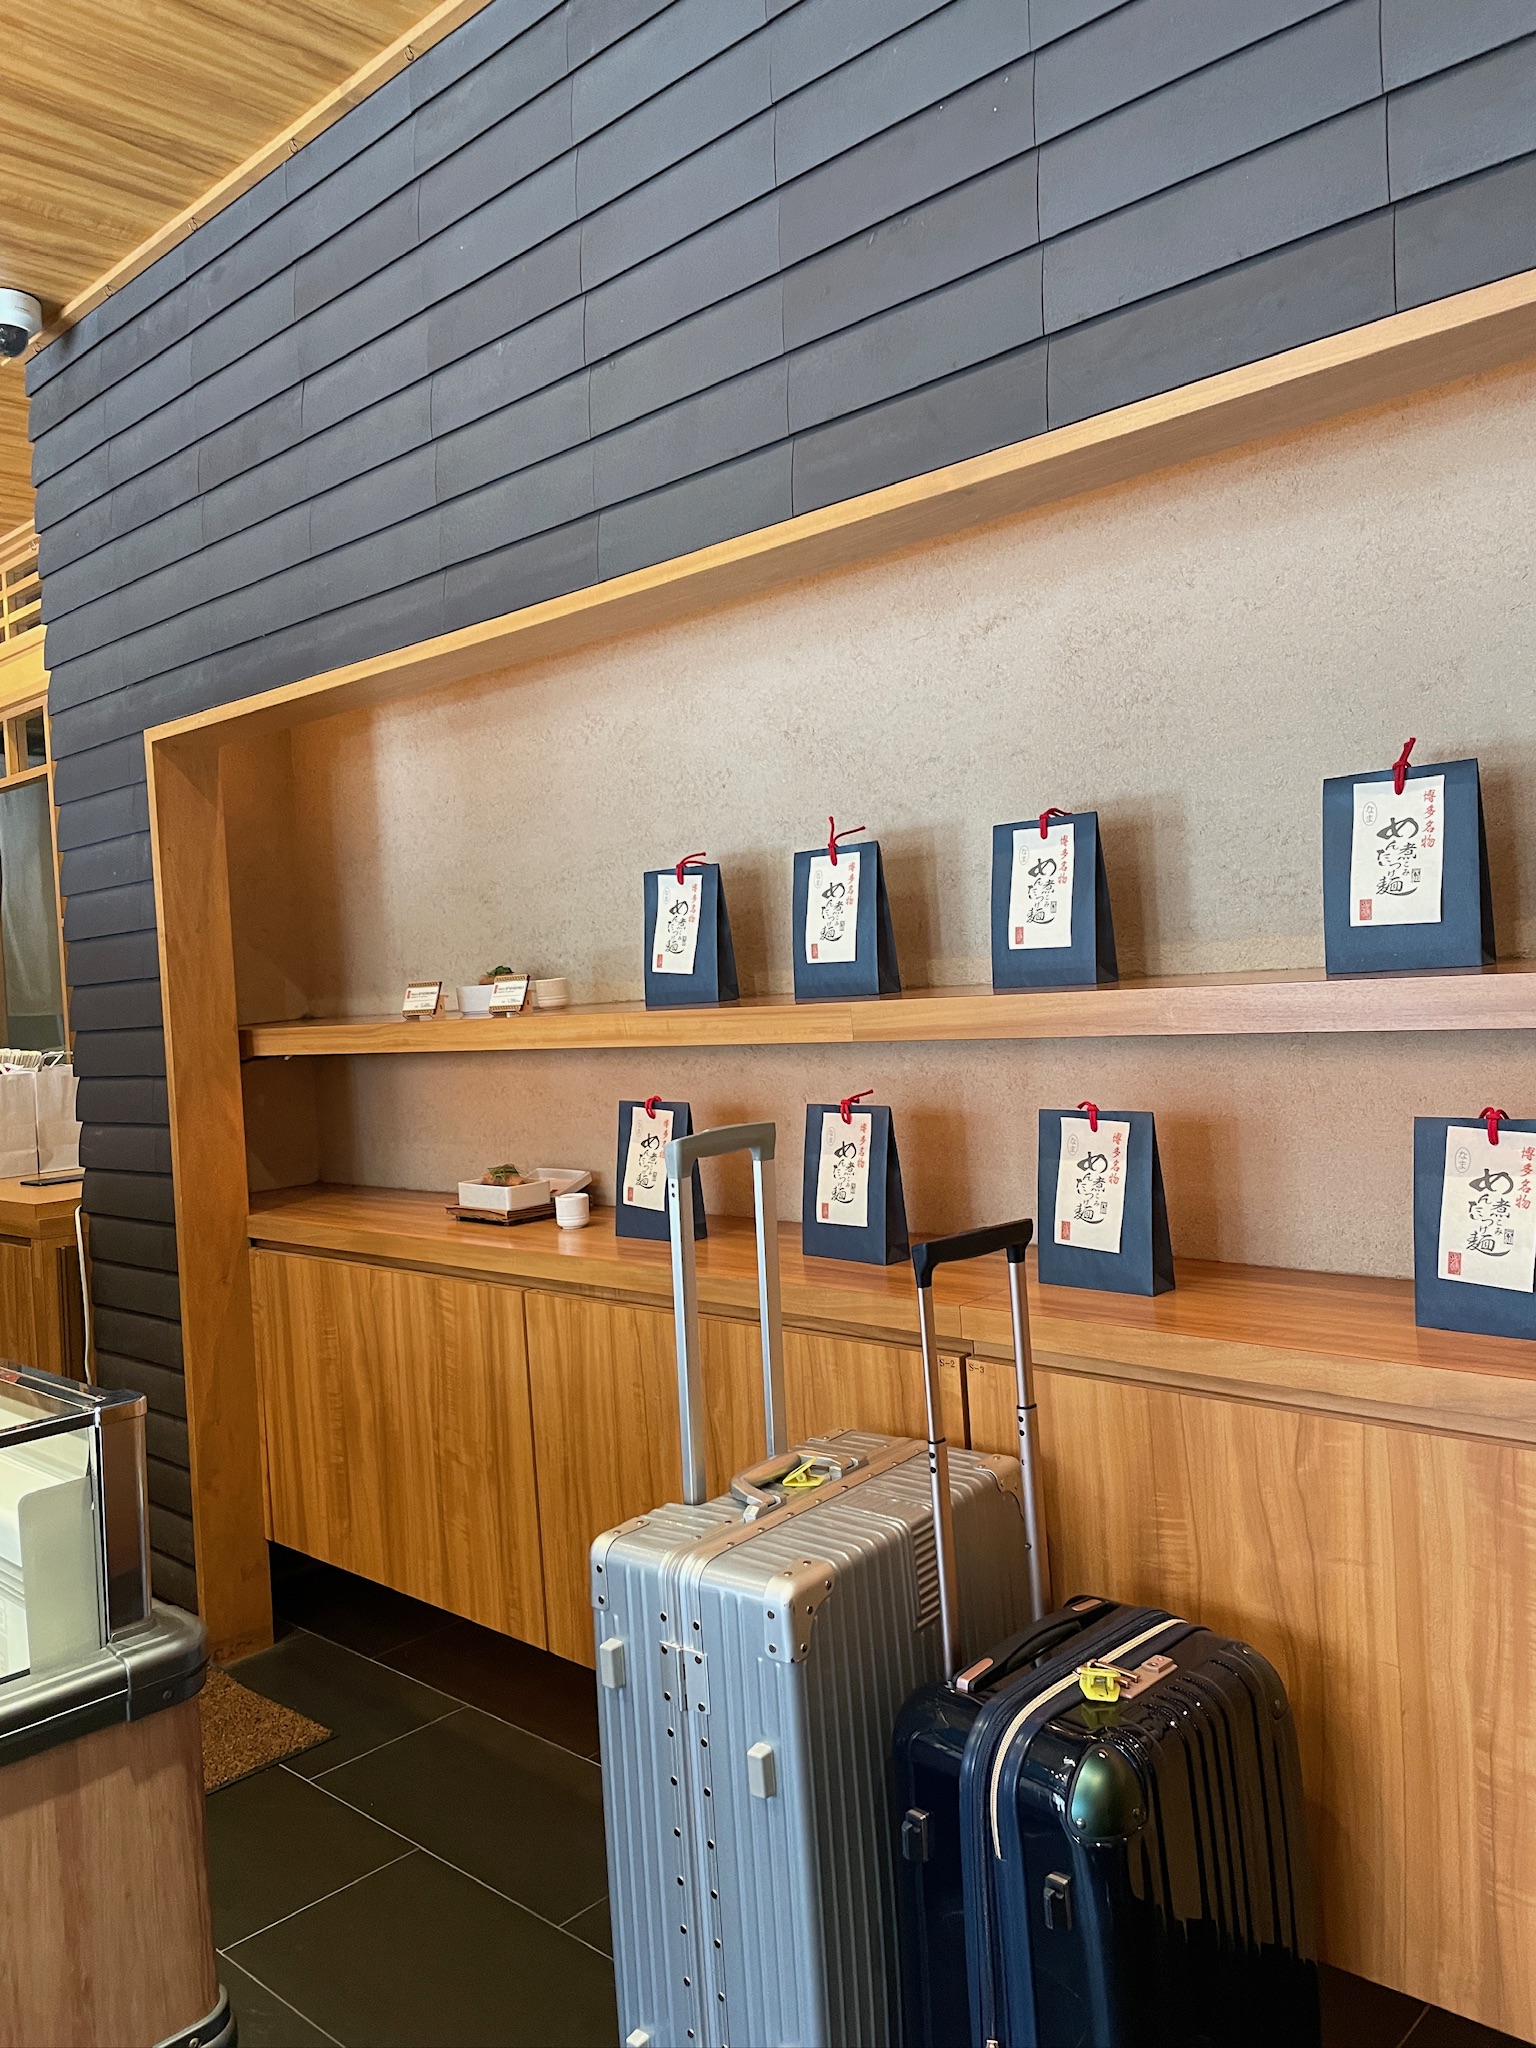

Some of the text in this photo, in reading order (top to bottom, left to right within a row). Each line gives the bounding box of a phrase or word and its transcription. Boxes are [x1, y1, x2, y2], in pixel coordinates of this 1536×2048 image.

[1366, 805, 1374, 823] なま
[1421, 789, 1437, 848] 博多名物
[1058, 835, 1069, 884] 博多名物
[1458, 1151, 1467, 1170] なま
[1515, 1146, 1536, 1210] 博多名物
[940, 1359, 955, 1368] S-2
[969, 1364, 985, 1374] S-3
